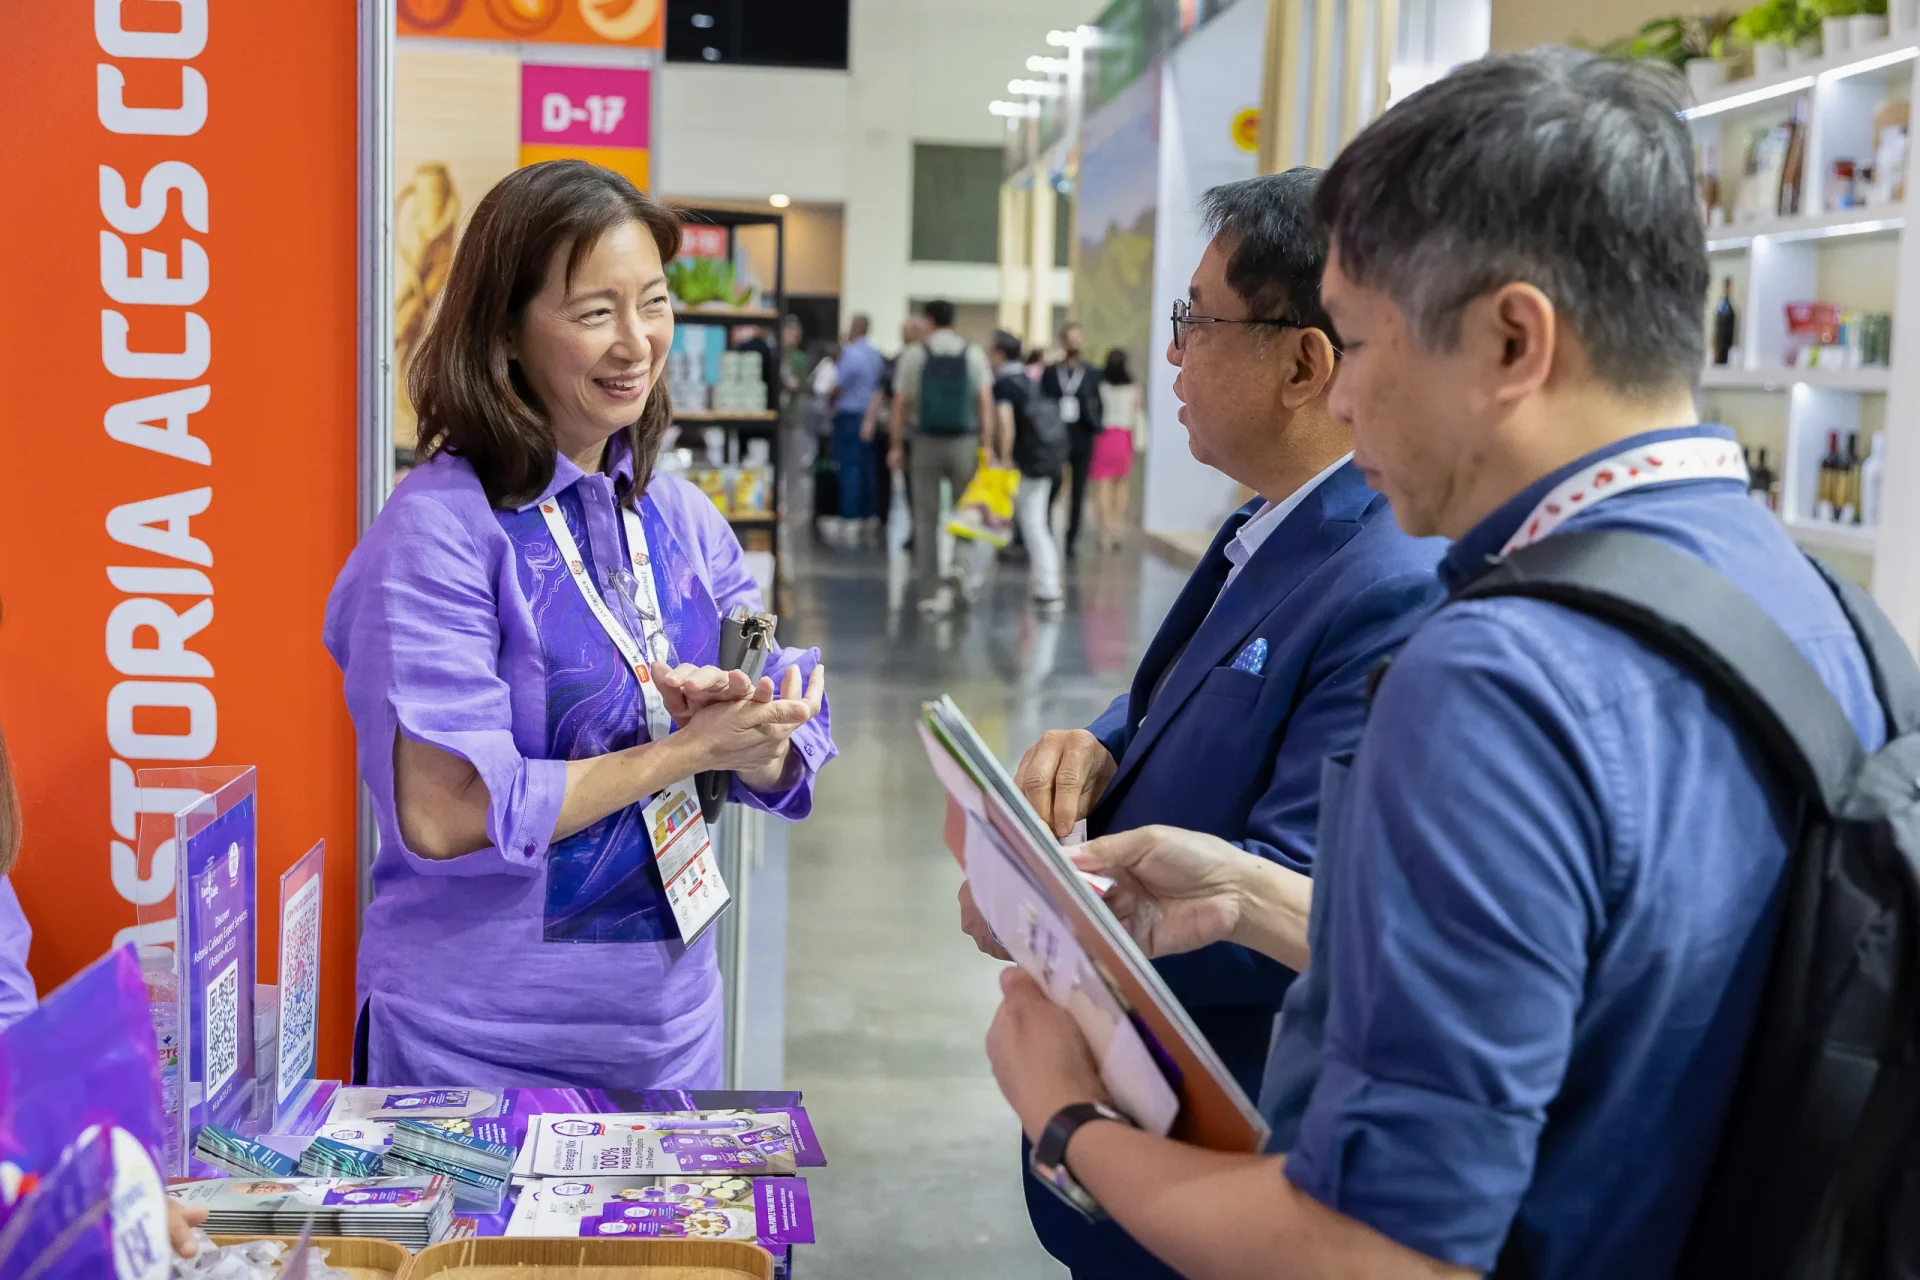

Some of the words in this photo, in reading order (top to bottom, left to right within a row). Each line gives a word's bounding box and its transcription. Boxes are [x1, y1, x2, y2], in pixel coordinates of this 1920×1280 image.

[542, 92, 627, 134] D-17
[99, 160, 212, 466] ACES
[215, 908, 230, 928] Discover
[194, 945, 208, 965] Astoria
[209, 932, 223, 952] Culinary
[224, 919, 234, 938] Expert
[235, 909, 248, 928] Services
[565, 1140, 577, 1149] Mix
[621, 1147, 632, 1156] UBE
[635, 1138, 645, 1156] Philippine
[562, 1149, 579, 1170] Beverage
[600, 1147, 620, 1170] 100%
[621, 1157, 632, 1169] PURE
[635, 1156, 643, 1169] Astoria
[645, 1147, 654, 1161] Powder
[645, 1161, 654, 1169] Ube
